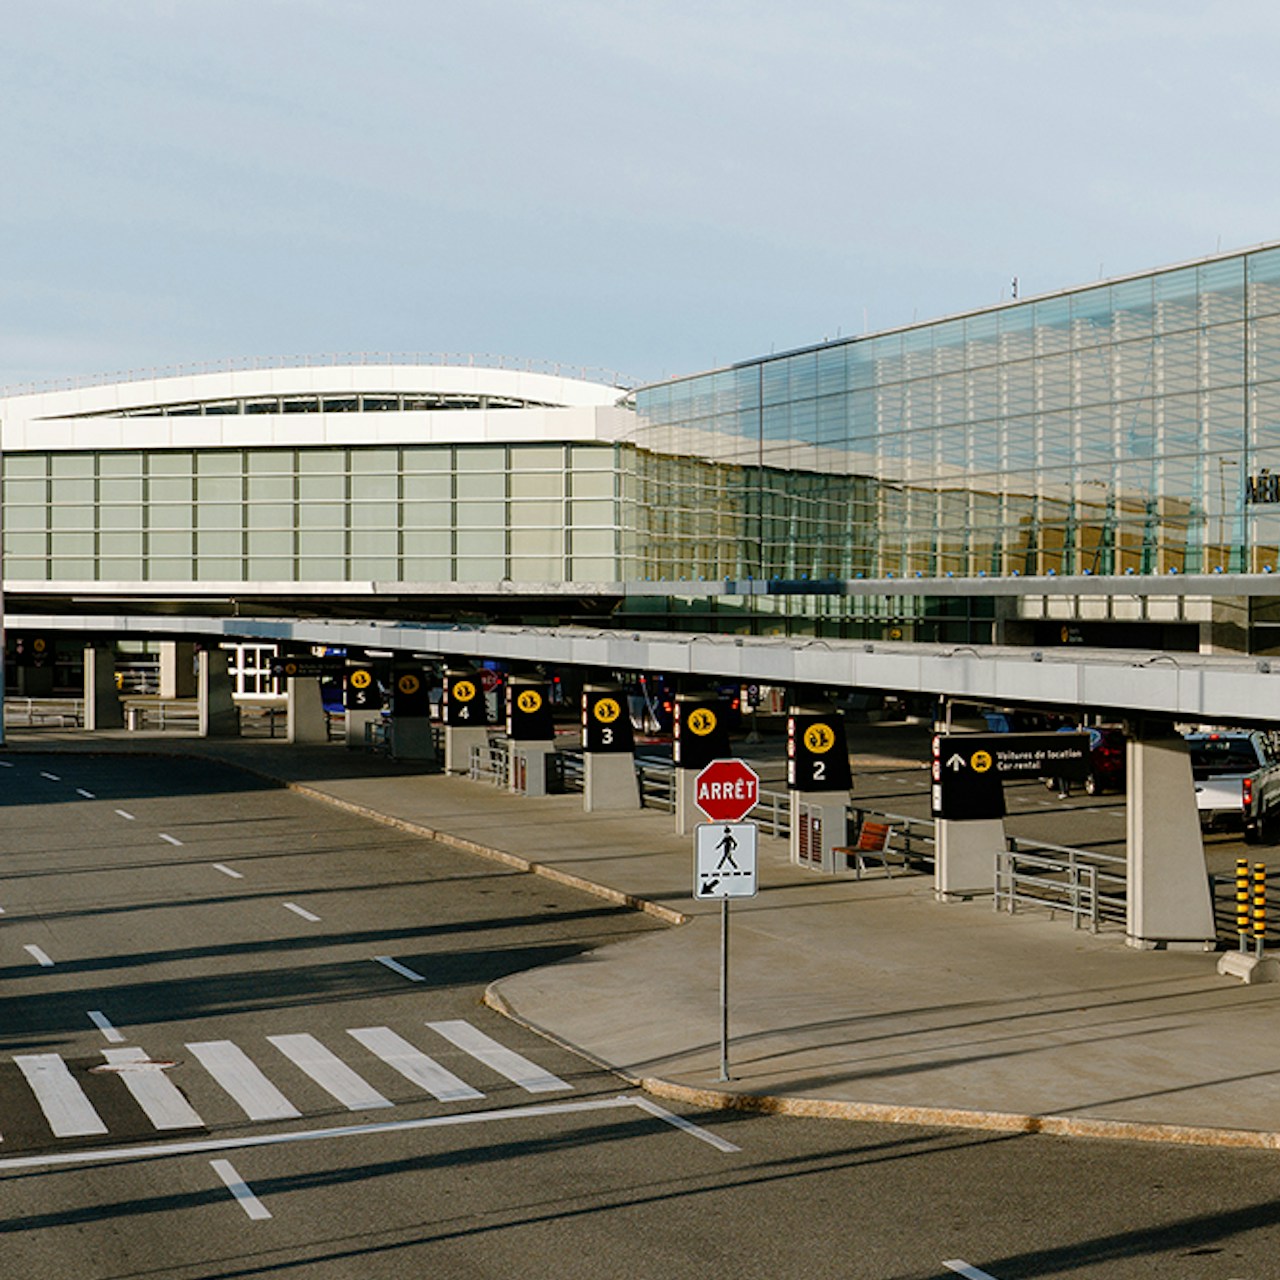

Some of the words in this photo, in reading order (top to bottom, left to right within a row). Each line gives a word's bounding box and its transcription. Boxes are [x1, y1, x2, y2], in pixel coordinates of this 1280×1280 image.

[356, 691, 367, 704] 5
[458, 706, 470, 719] 4
[601, 728, 614, 744] 3
[996, 750, 1032, 760] Voitures
[1034, 750, 1045, 759] de
[1047, 748, 1082, 759] location
[812, 761, 826, 780] 2
[996, 762, 1013, 771] Car
[1014, 760, 1041, 769] rental
[698, 778, 755, 800] ARRÊT
